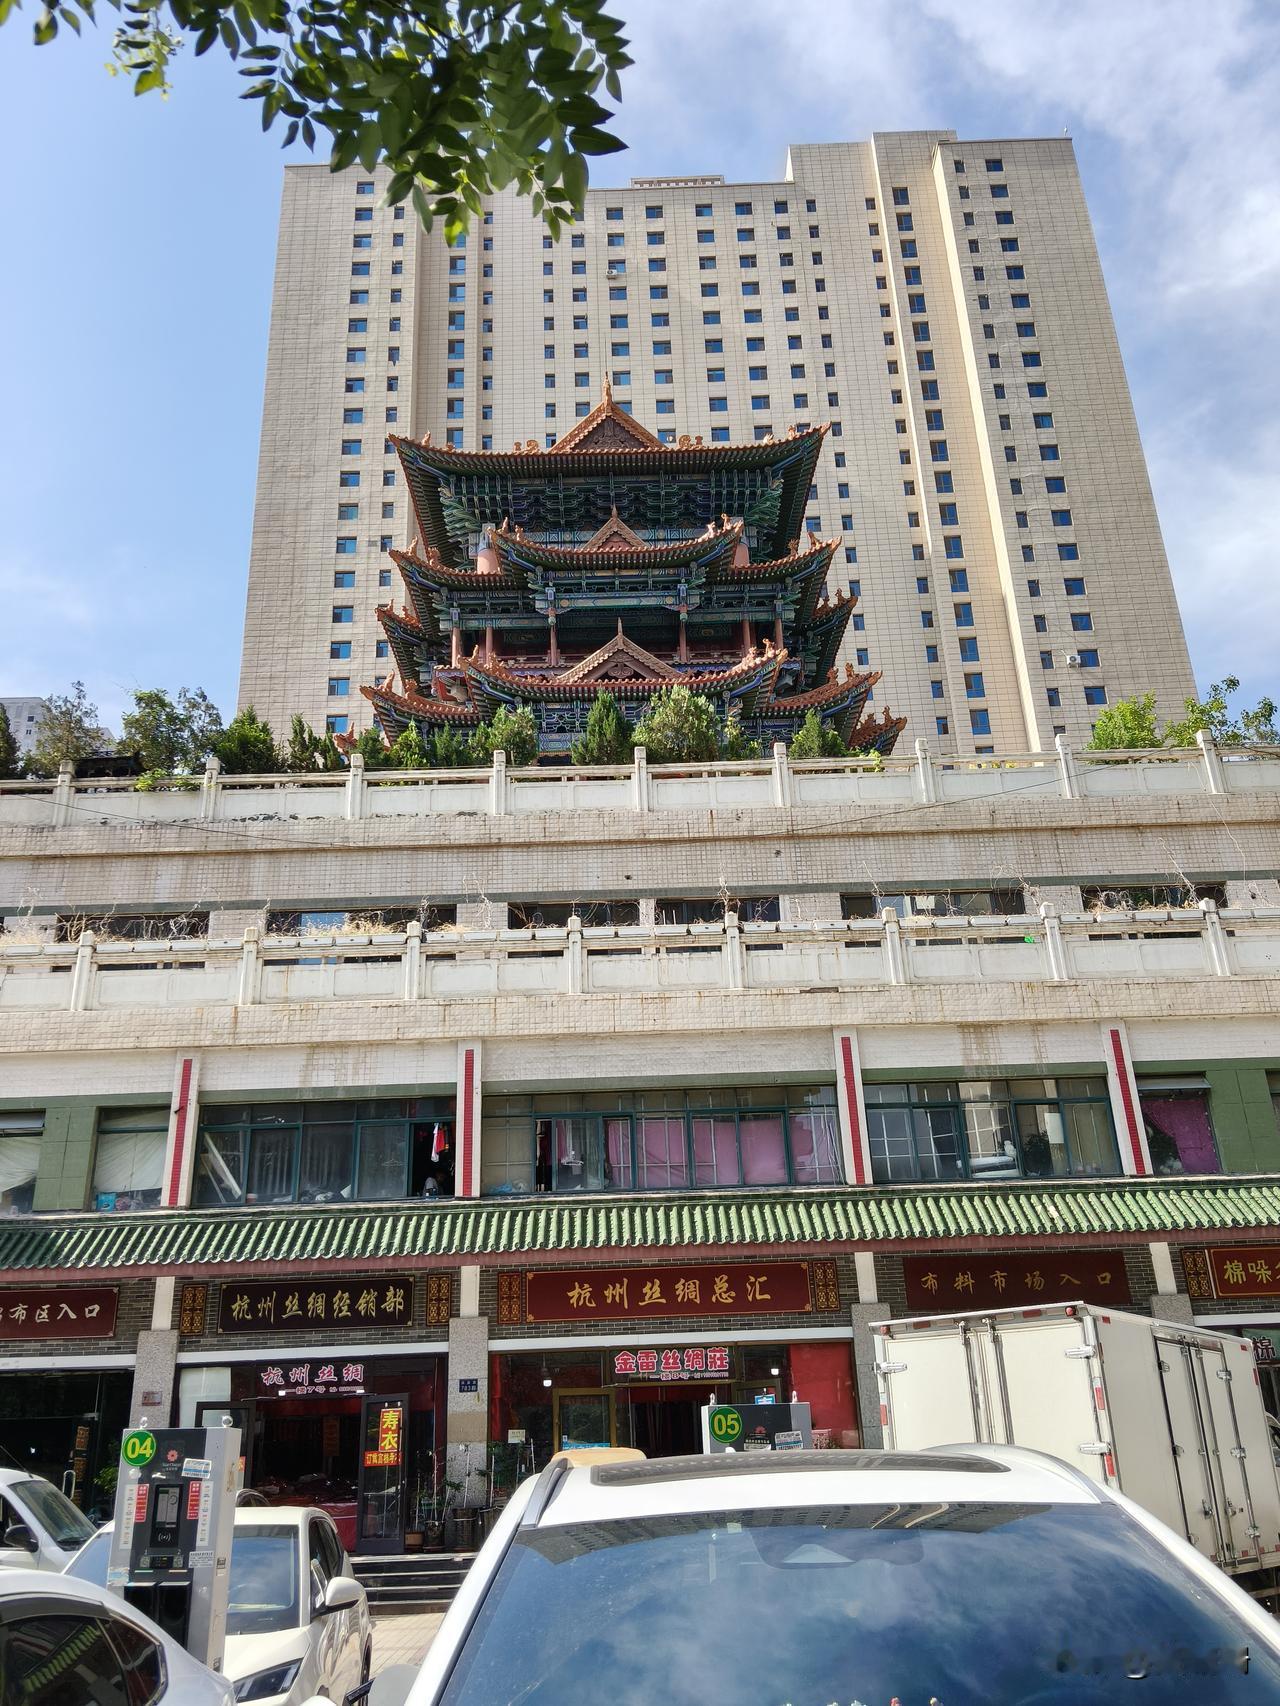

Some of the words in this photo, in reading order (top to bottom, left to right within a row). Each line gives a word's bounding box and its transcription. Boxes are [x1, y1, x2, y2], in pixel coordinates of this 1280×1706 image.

[921, 1270, 1112, 1295] 布料市场入口
[1223, 1259, 1280, 1285] 棉哚
[567, 1274, 772, 1310] 杭州丝绸总汇
[0, 1303, 101, 1326] 布区入口
[231, 1285, 406, 1325] 杭州丝绸经销部
[260, 1363, 365, 1386] 杭州丝绸
[380, 1410, 400, 1450] 寿衣
[713, 1414, 740, 1436] 05
[126, 1438, 153, 1458] 04
